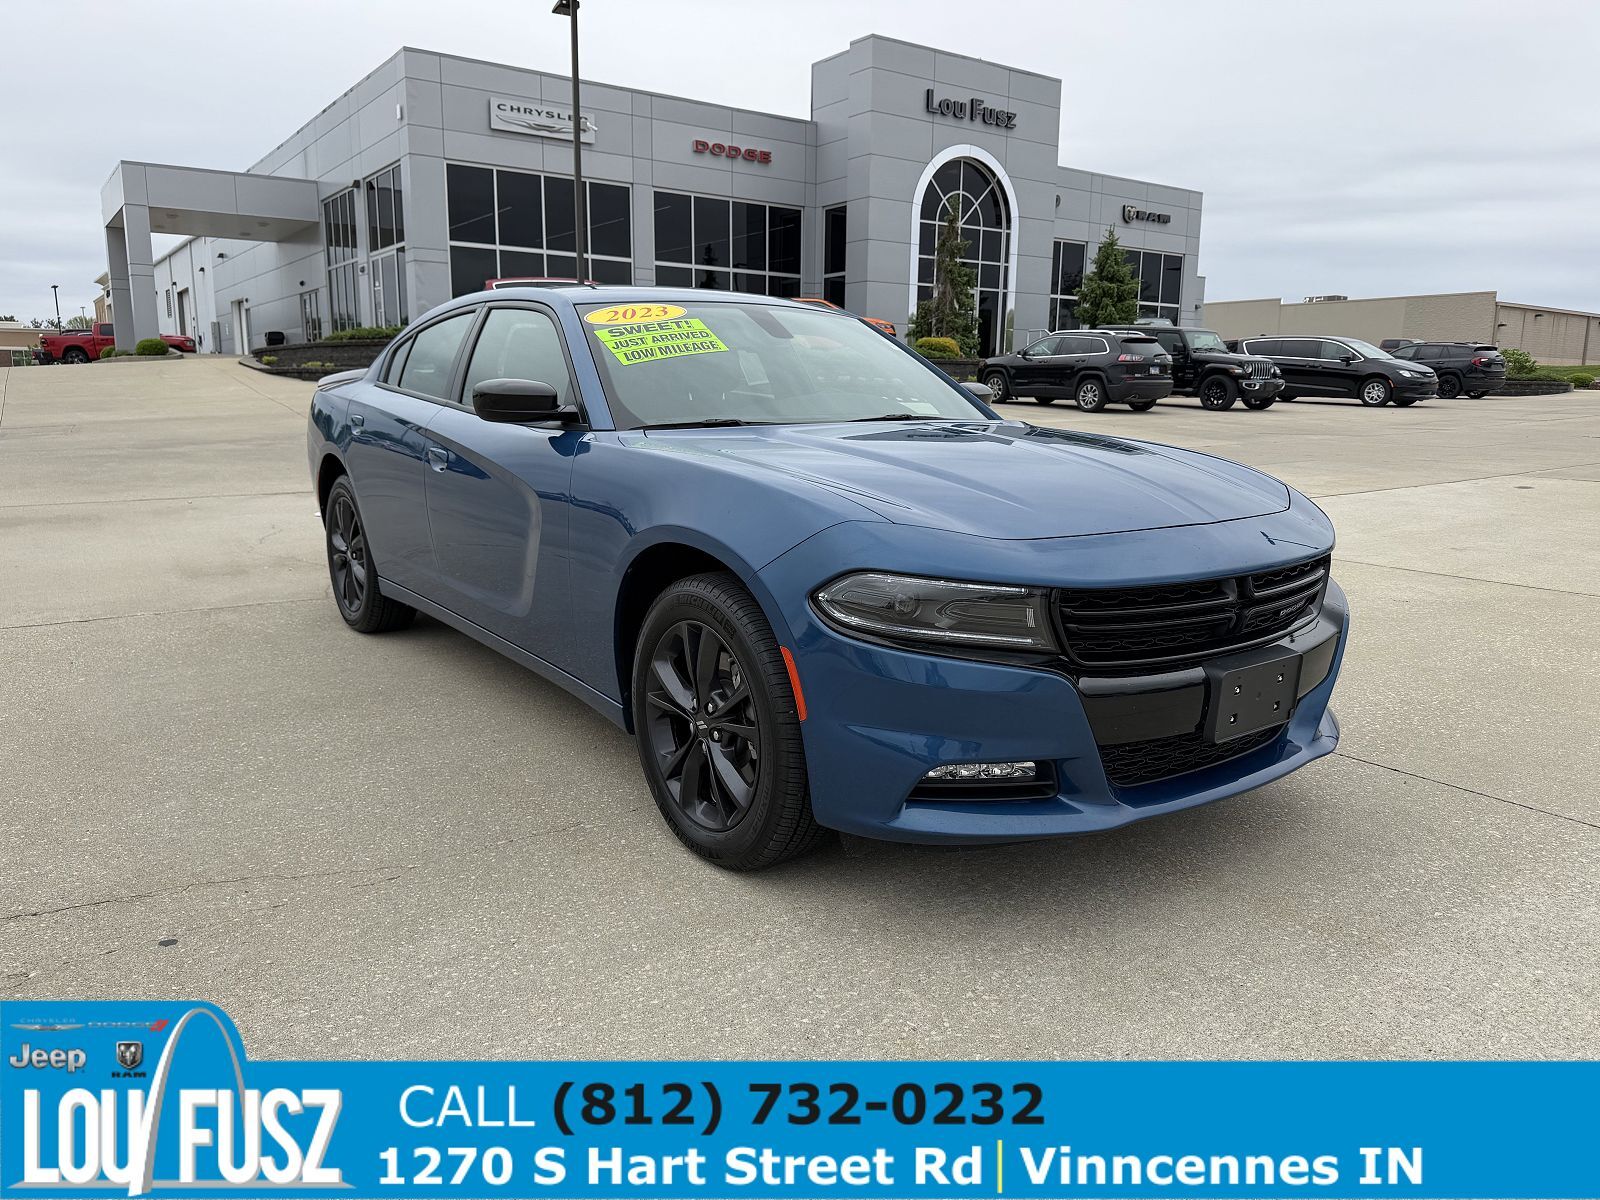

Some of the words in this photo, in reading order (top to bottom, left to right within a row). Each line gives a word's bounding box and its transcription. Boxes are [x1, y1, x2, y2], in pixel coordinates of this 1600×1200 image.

[926, 88, 967, 119] Lou
[970, 97, 1017, 129] Fusz
[692, 139, 772, 164] DODGE
[1135, 210, 1171, 224] RAM
[606, 306, 669, 322] 2023
[608, 321, 692, 337] SWEET!
[612, 337, 647, 350] JUST
[651, 331, 711, 344] ARRIVED
[624, 349, 655, 362] LOW
[659, 341, 719, 356] MILEAGE
